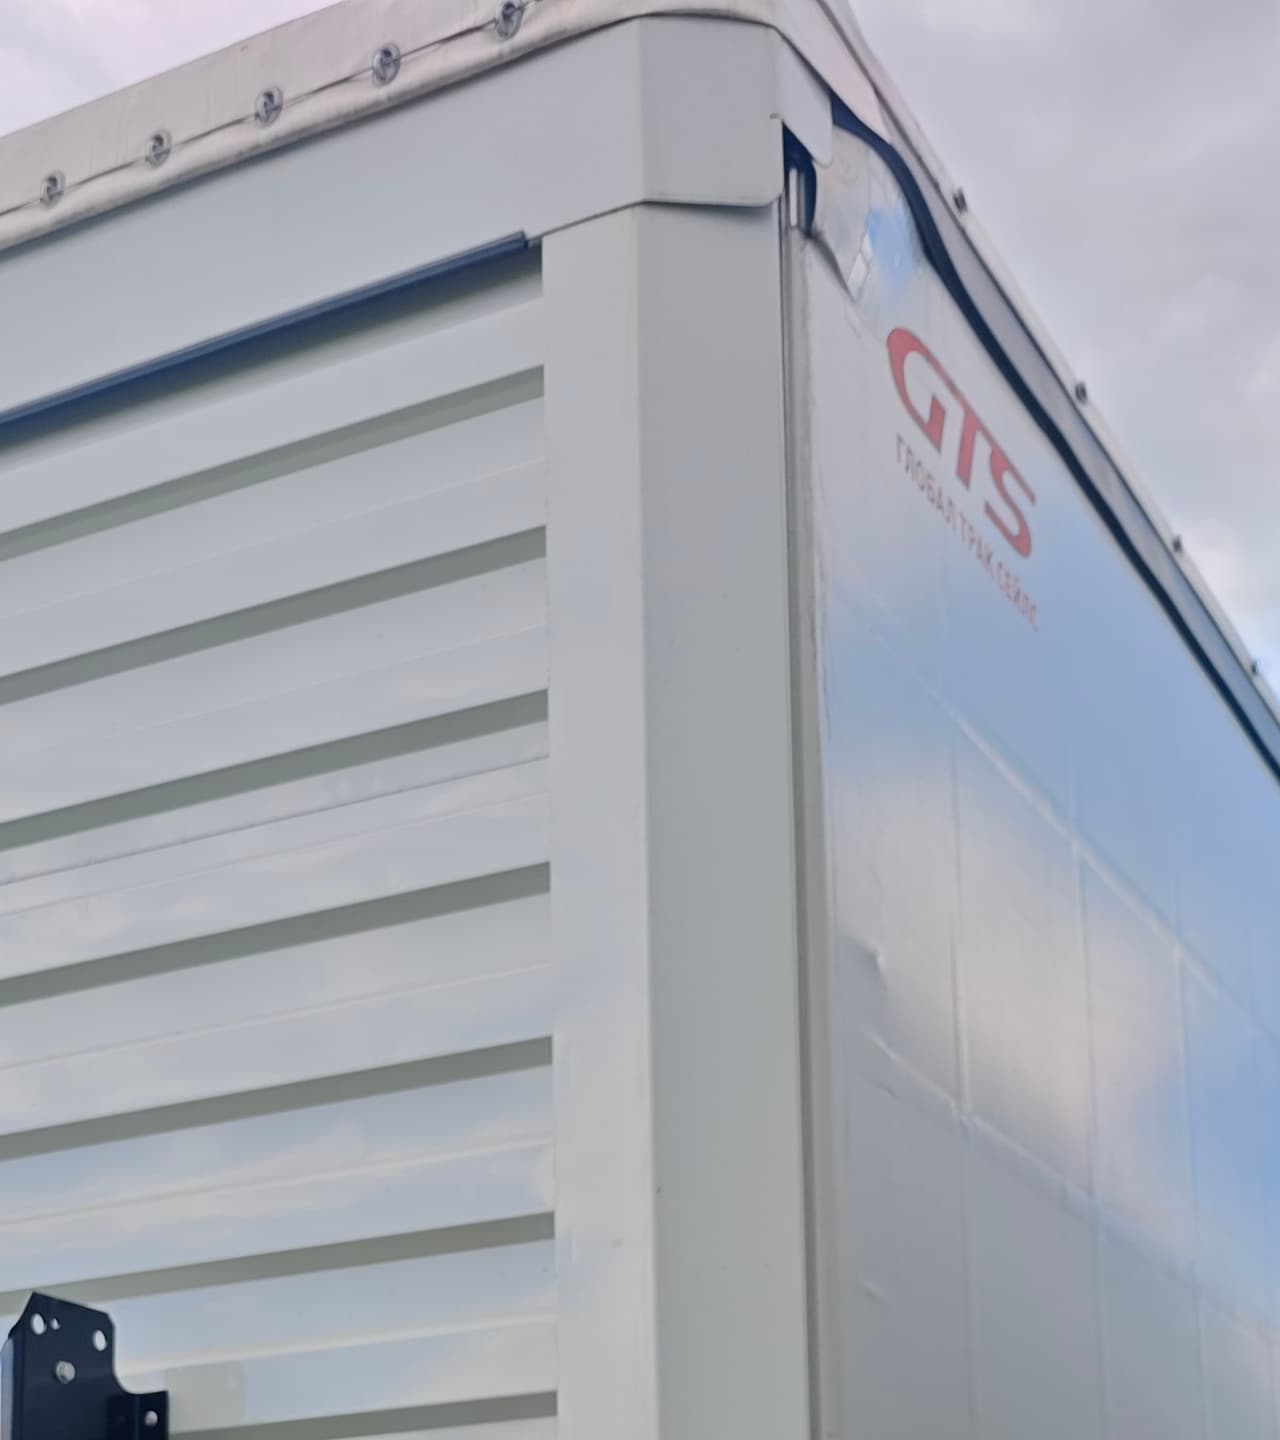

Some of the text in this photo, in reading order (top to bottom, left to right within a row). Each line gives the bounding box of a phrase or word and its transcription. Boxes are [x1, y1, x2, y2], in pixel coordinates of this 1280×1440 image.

[887, 327, 1036, 558] GTS
[896, 432, 957, 531] ГЛОБАЛ
[958, 511, 995, 579] ТРАК
